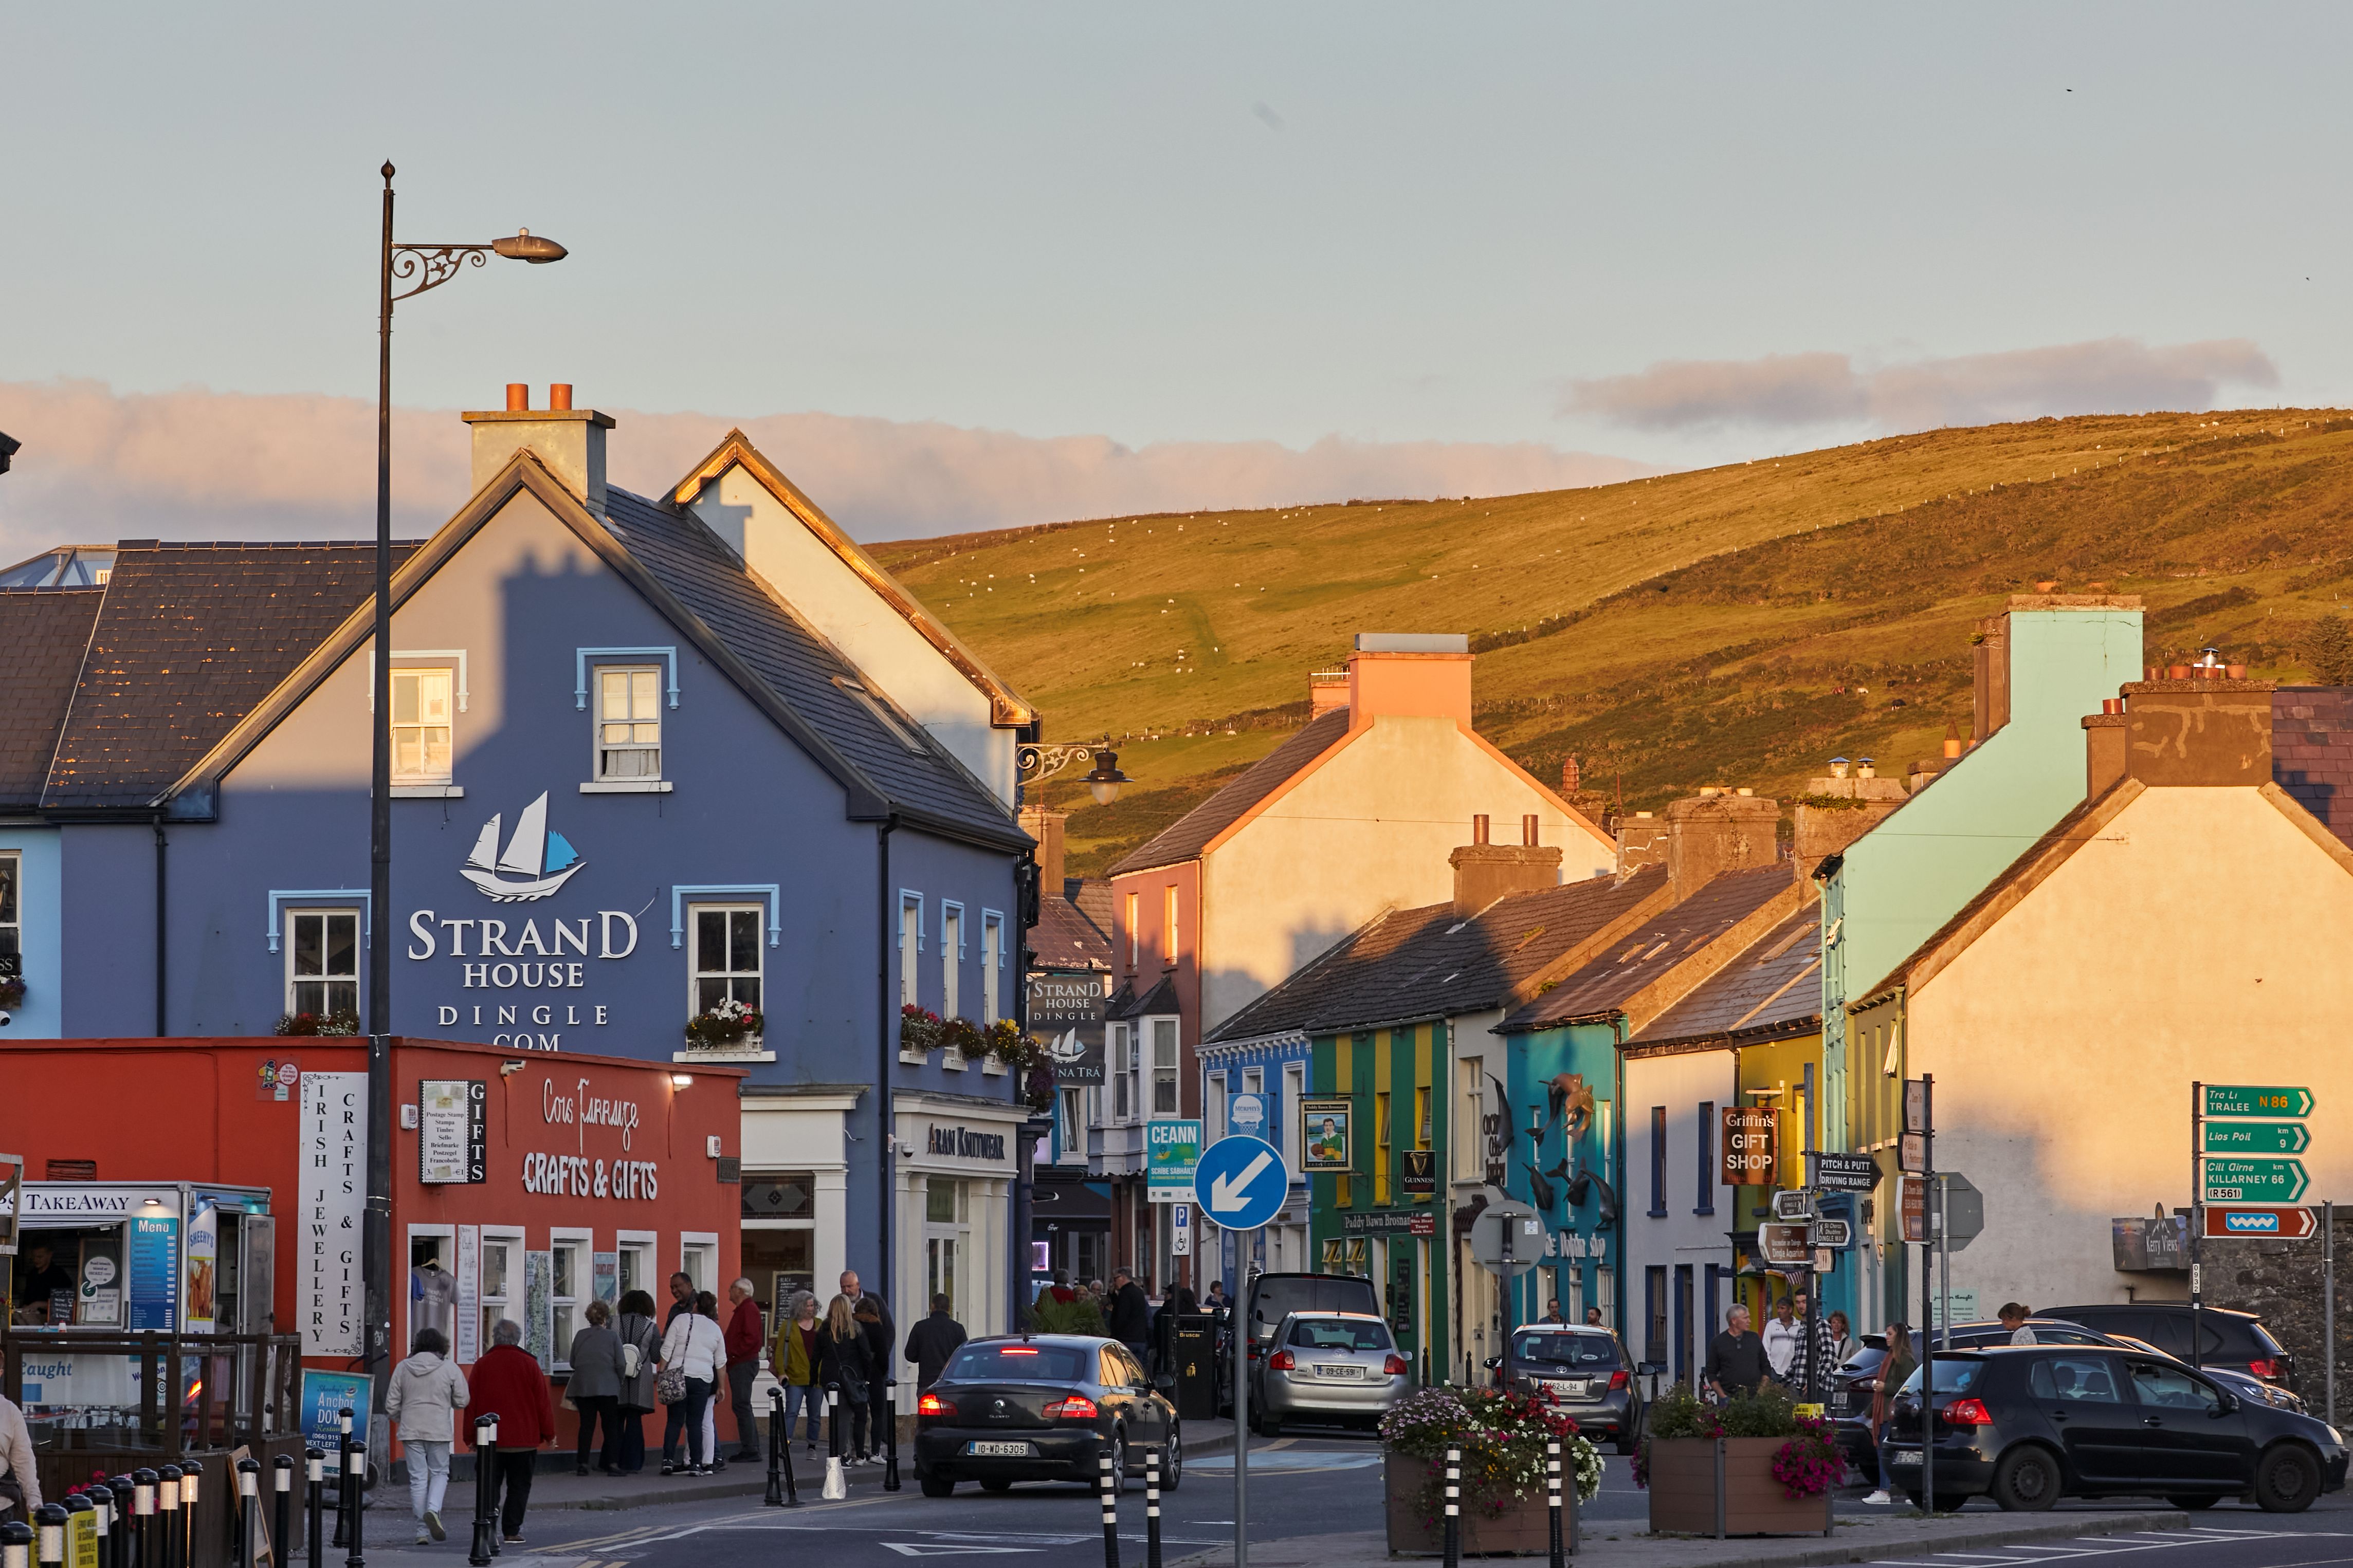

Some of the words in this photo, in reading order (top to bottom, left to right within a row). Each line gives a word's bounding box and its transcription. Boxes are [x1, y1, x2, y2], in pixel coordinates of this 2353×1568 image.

[408, 910, 637, 960] STRAND
[463, 963, 583, 988] HOUSE
[1034, 982, 1101, 998] STRAND
[1046, 999, 1090, 1008] HOUSE
[438, 1005, 607, 1025] DINGLE
[493, 1034, 560, 1052] COM
[1059, 1068, 1075, 1077] NA
[1077, 1066, 1101, 1077] TRÁ
[2210, 1090, 2224, 1099] Trá
[2259, 1096, 2268, 1108] N
[2271, 1096, 2288, 1108] 86
[2210, 1102, 2250, 1112] TRALEE
[314, 1084, 327, 1167] IRISH
[1726, 1114, 1774, 1127] Griffin's
[471, 1084, 485, 1180] GIFTS
[1152, 1126, 1196, 1143] CEANN
[2209, 1132, 2229, 1141] Lios
[2232, 1132, 2251, 1141] Póil
[342, 1093, 355, 1194] CRAFTS
[927, 1122, 955, 1155] ARAN
[957, 1127, 1005, 1160] KNITWEAR
[1731, 1134, 1768, 1149] GIFT
[2279, 1139, 2286, 1148] 9
[1726, 1155, 1773, 1170] SHOP
[1821, 1159, 1842, 1169] PITCH
[1845, 1160, 1850, 1169] &
[1851, 1161, 1870, 1170] PUTT
[2208, 1163, 2224, 1171] Cill
[523, 1152, 589, 1197] CRAFTS
[593, 1159, 608, 1197] &
[612, 1159, 658, 1200] GIFTS
[1170, 1166, 1195, 1175] SÁBHÁILT
[1821, 1176, 1847, 1186] DRIVING
[1849, 1177, 1870, 1186] RANGE
[2209, 1175, 2267, 1184] KILLARNEY
[2271, 1175, 2284, 1184] 66
[2210, 1189, 2219, 1197] (R
[2221, 1189, 2240, 1198] 561)
[341, 1215, 353, 1229] &
[1178, 1208, 1184, 1225] P
[1345, 1215, 1364, 1231] Paddy
[1365, 1214, 1383, 1227] Bawn
[138, 1220, 169, 1233] Menu
[190, 1230, 214, 1248] SHEEHY'S
[2146, 1235, 2160, 1255] Kerry
[2162, 1235, 2177, 1252] Views
[1772, 1248, 1785, 1259] Dingle
[1786, 1248, 1804, 1258] Aquarium
[312, 1190, 327, 1342] JEWELLERY
[339, 1250, 353, 1334] GIFTS
[318, 1392, 355, 1409] Anchor
[318, 1409, 342, 1425] DOW
[978, 1445, 1025, 1454] 10-WD-6305
